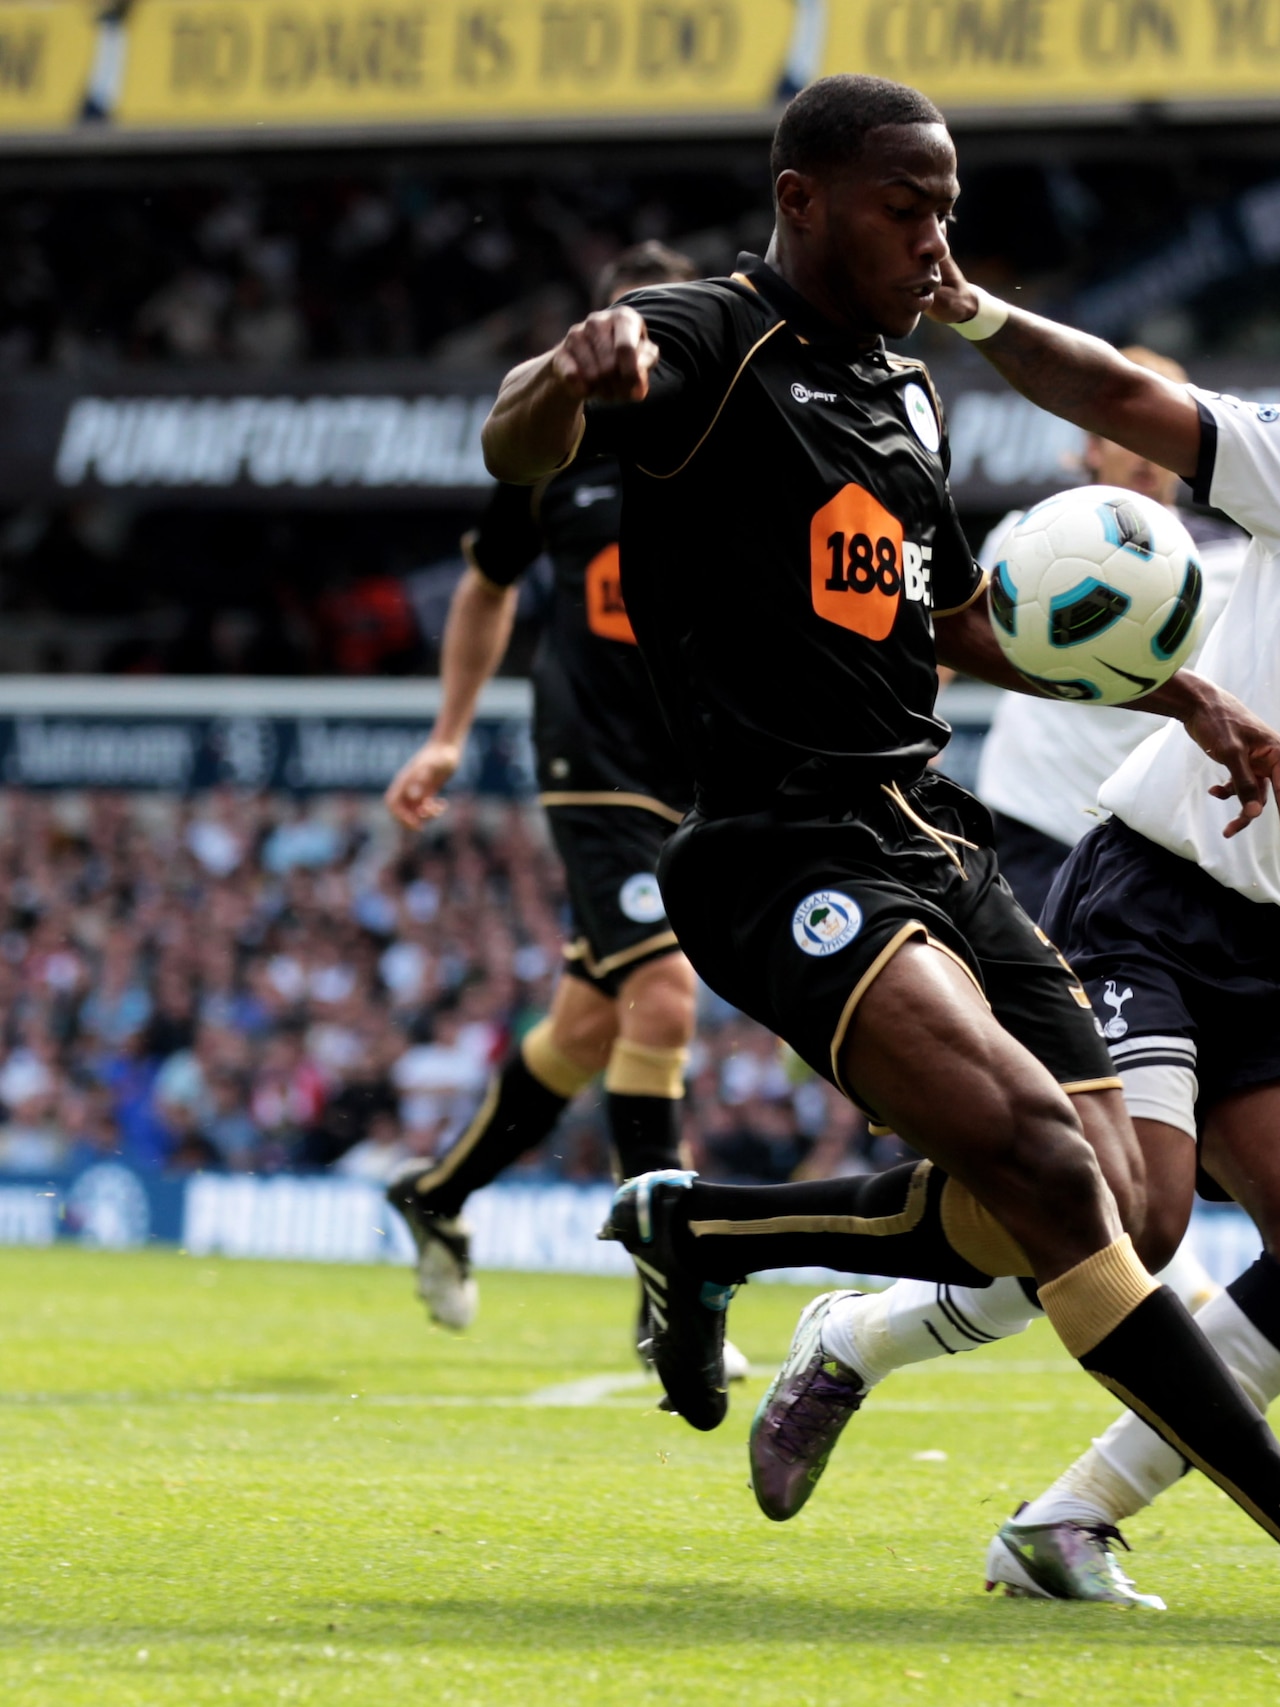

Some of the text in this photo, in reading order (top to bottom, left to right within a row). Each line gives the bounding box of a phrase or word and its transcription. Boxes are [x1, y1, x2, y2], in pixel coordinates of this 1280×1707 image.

[170, 4, 738, 94] TO DARE IS TO DO
[865, 0, 1045, 72] COME
[1078, 0, 1184, 68] ON
[794, 892, 830, 925] WIGAN
